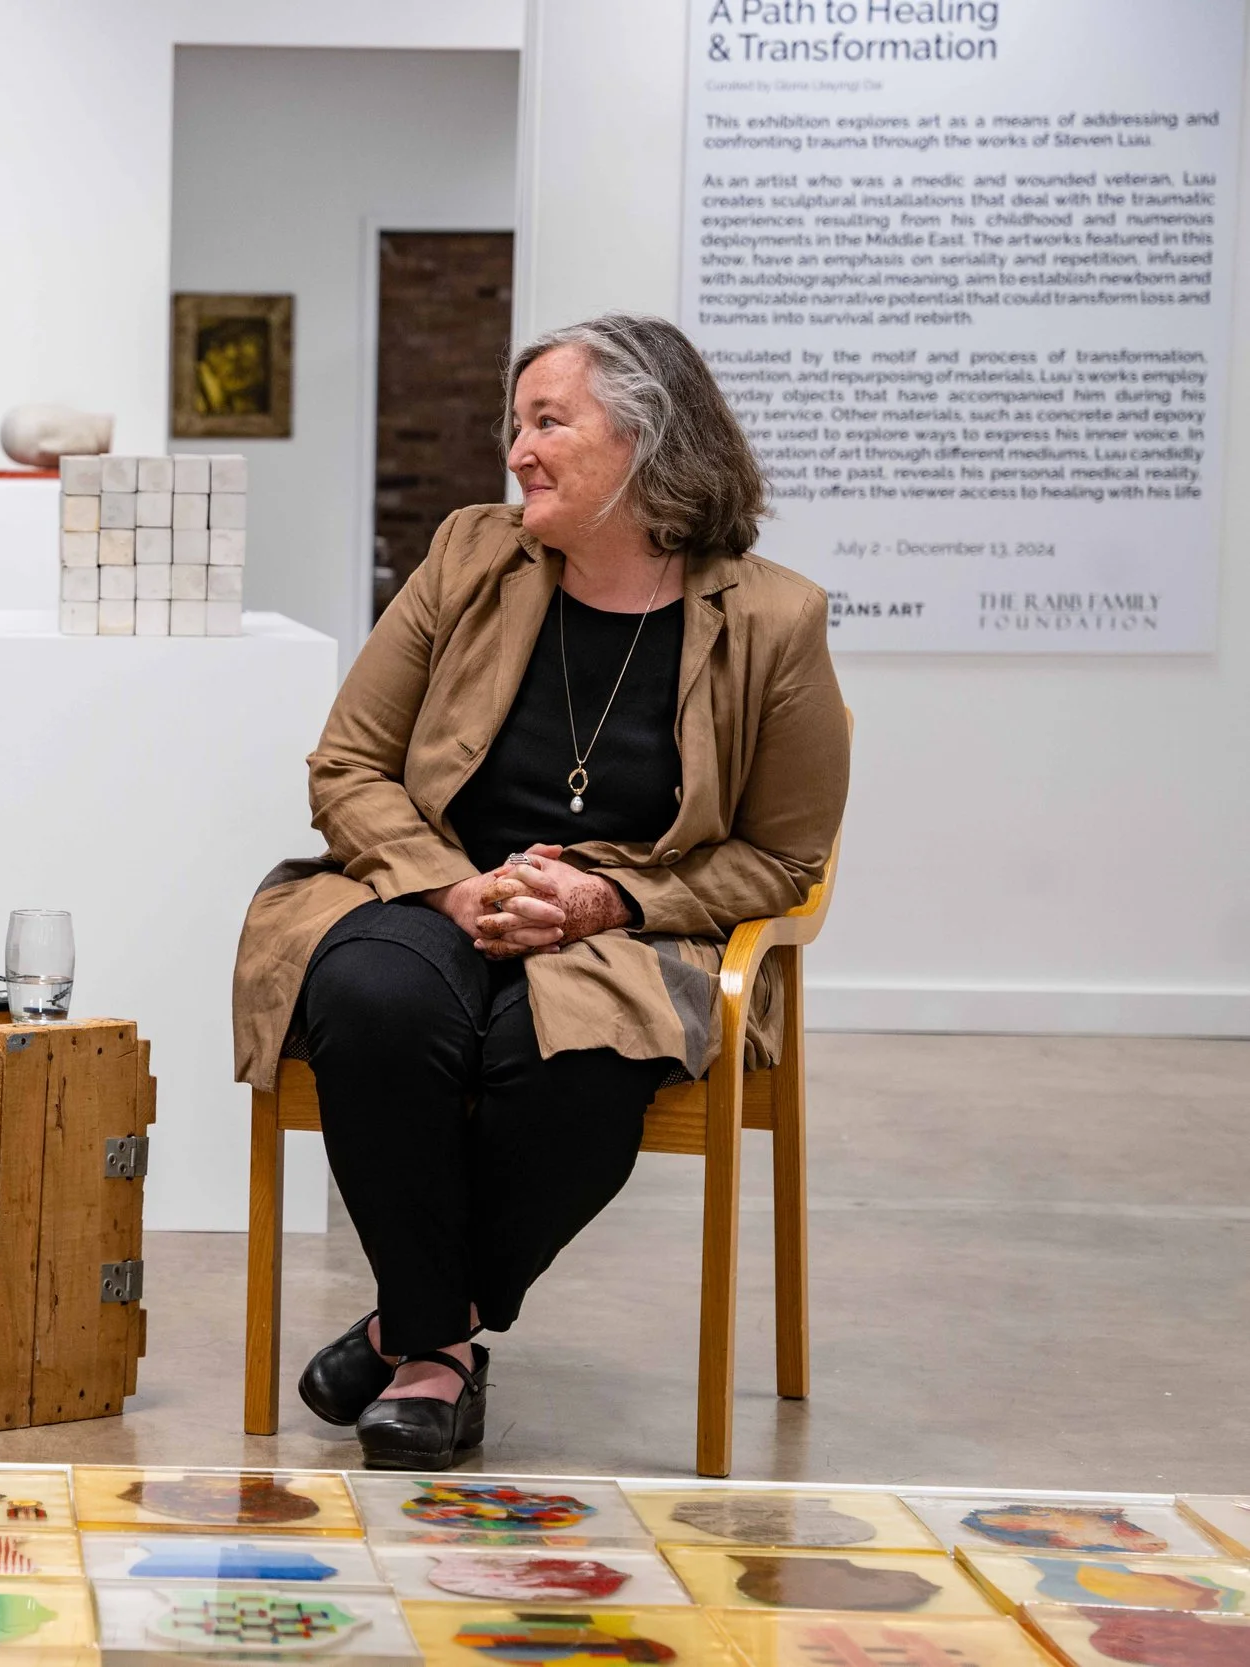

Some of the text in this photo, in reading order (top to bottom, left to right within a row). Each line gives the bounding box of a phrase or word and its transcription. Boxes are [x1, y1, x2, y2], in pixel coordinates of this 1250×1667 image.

[709, 0, 999, 31] A Path to Healing
[707, 32, 998, 61] & Transformation
[707, 110, 1219, 131] This exhibition explores art means addressing and
[703, 133, 802, 152] confronting
[806, 132, 867, 147] trauma
[872, 132, 939, 151] through
[943, 132, 971, 147] the
[976, 131, 1027, 146] works
[1053, 131, 1112, 146] Steven
[754, 172, 797, 187] artist
[806, 172, 842, 187] who
[850, 175, 884, 186] was
[911, 171, 963, 186] medic
[974, 171, 1006, 186] and
[1015, 171, 1096, 186] wounded
[1182, 170, 1216, 185] Luu
[702, 190, 1214, 211] creates sculptural installations that deal with the traumatic
[701, 210, 1214, 230] experiences resulting from his childhood and numerous
[700, 231, 812, 250] deployments
[834, 231, 862, 246] the
[865, 231, 924, 246] Middle
[973, 231, 1003, 246] The
[1007, 231, 1082, 246] artworks
[1085, 230, 1159, 245] featured
[1181, 230, 1212, 245] this
[751, 250, 792, 265] have
[823, 250, 904, 269] emphasis
[939, 250, 1006, 269] seriality
[1013, 250, 1046, 265] and
[1146, 250, 1212, 265] infused
[700, 270, 736, 285] with
[738, 270, 882, 289] autobiographical
[1018, 270, 1096, 285] establish
[1098, 270, 1176, 285] newborn
[1178, 270, 1211, 285] and
[699, 289, 1210, 309] recognizable narrative potential could transform and
[698, 309, 767, 324] traumas
[771, 309, 804, 324] into
[808, 309, 873, 324] survival
[877, 309, 910, 324] and
[801, 348, 822, 367] by
[832, 348, 860, 363] the
[871, 348, 916, 363] motif
[927, 348, 959, 363] and
[969, 351, 1037, 367] process
[796, 368, 830, 383] and
[830, 368, 934, 387] repurposing
[1086, 368, 1138, 383] works
[1141, 368, 1206, 387] employ
[782, 387, 1171, 406] objects that have accompanied him during
[830, 406, 877, 421] Other
[969, 406, 1009, 421] such
[1036, 406, 1112, 421] concrete
[1116, 406, 1149, 421] and
[1152, 410, 1204, 425] epoxy
[776, 426, 818, 441] used
[845, 426, 909, 445] explore
[914, 429, 956, 445] ways
[984, 429, 1050, 445] express
[1084, 425, 1127, 440] inner
[864, 445, 931, 464] through
[933, 445, 1004, 460] different
[1094, 445, 1127, 460] Luu
[1129, 445, 1203, 464] candidly
[813, 465, 841, 480] the
[893, 465, 954, 480] reveals
[960, 465, 984, 480] his
[990, 465, 1064, 484] personal
[1070, 465, 1139, 480] medical
[819, 484, 1201, 503] offers viewer access healing with life
[831, 539, 867, 559] July
[870, 542, 881, 557] 2
[896, 538, 986, 557] December
[1015, 542, 1056, 558] 2024
[830, 602, 925, 617] RANS ART
[978, 592, 1161, 612] THE RABB FAMILY
[978, 615, 1159, 632] FOUNDATION
